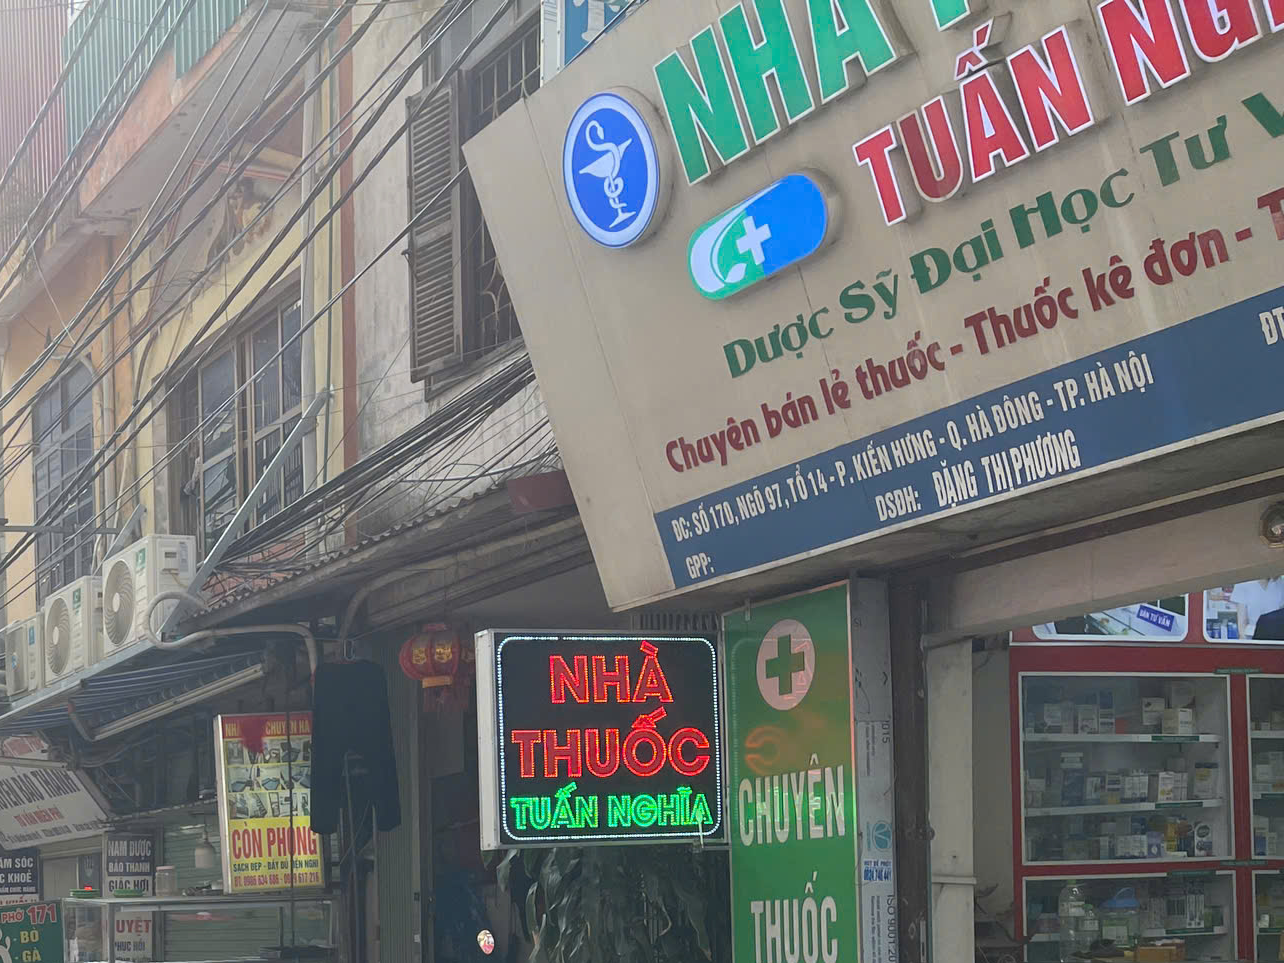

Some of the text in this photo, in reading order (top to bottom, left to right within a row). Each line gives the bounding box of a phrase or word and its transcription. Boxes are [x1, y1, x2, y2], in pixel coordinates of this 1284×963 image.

[852, 19, 1095, 227] TUẤN
[723, 307, 835, 379] Dược
[839, 268, 899, 323] Sỹ
[910, 217, 1005, 295] Đại
[666, 231, 1230, 473] Chuyên bán lẻ thuốc Thuốc kê đơn
[692, 502, 711, 536] SỐ
[710, 502, 740, 531] 170,
[736, 485, 766, 521] NGÕ
[786, 463, 809, 504] TỔ
[807, 469, 829, 497] 14
[851, 440, 893, 481] KIẾN
[892, 429, 938, 469] HƯNG
[946, 420, 967, 451] Q.
[965, 404, 995, 443] HÀ
[991, 395, 1045, 434] ĐÔNG
[1053, 380, 1086, 412] TP.
[1083, 361, 1116, 403] HÀ
[1113, 350, 1155, 394] NỘI
[932, 460, 979, 509] ĐẶNG
[981, 450, 1015, 492] THỊ
[1011, 428, 1082, 488] PHƯƠNG
[685, 551, 715, 580] GPP:
[549, 640, 674, 704] NHÀ
[511, 706, 711, 778] THUỐC
[510, 782, 714, 830] TUẤN NGHĨA
[738, 753, 845, 847] CHUYÊN
[14, 855, 34, 868] SÓC
[107, 840, 128, 857] NAM
[232, 822, 263, 860] CÒN
[126, 861, 150, 873] THANH
[1, 908, 24, 924] PHỞ
[26, 904, 57, 924] 171
[20, 929, 39, 944] BÒ
[22, 946, 41, 963] GÀ
